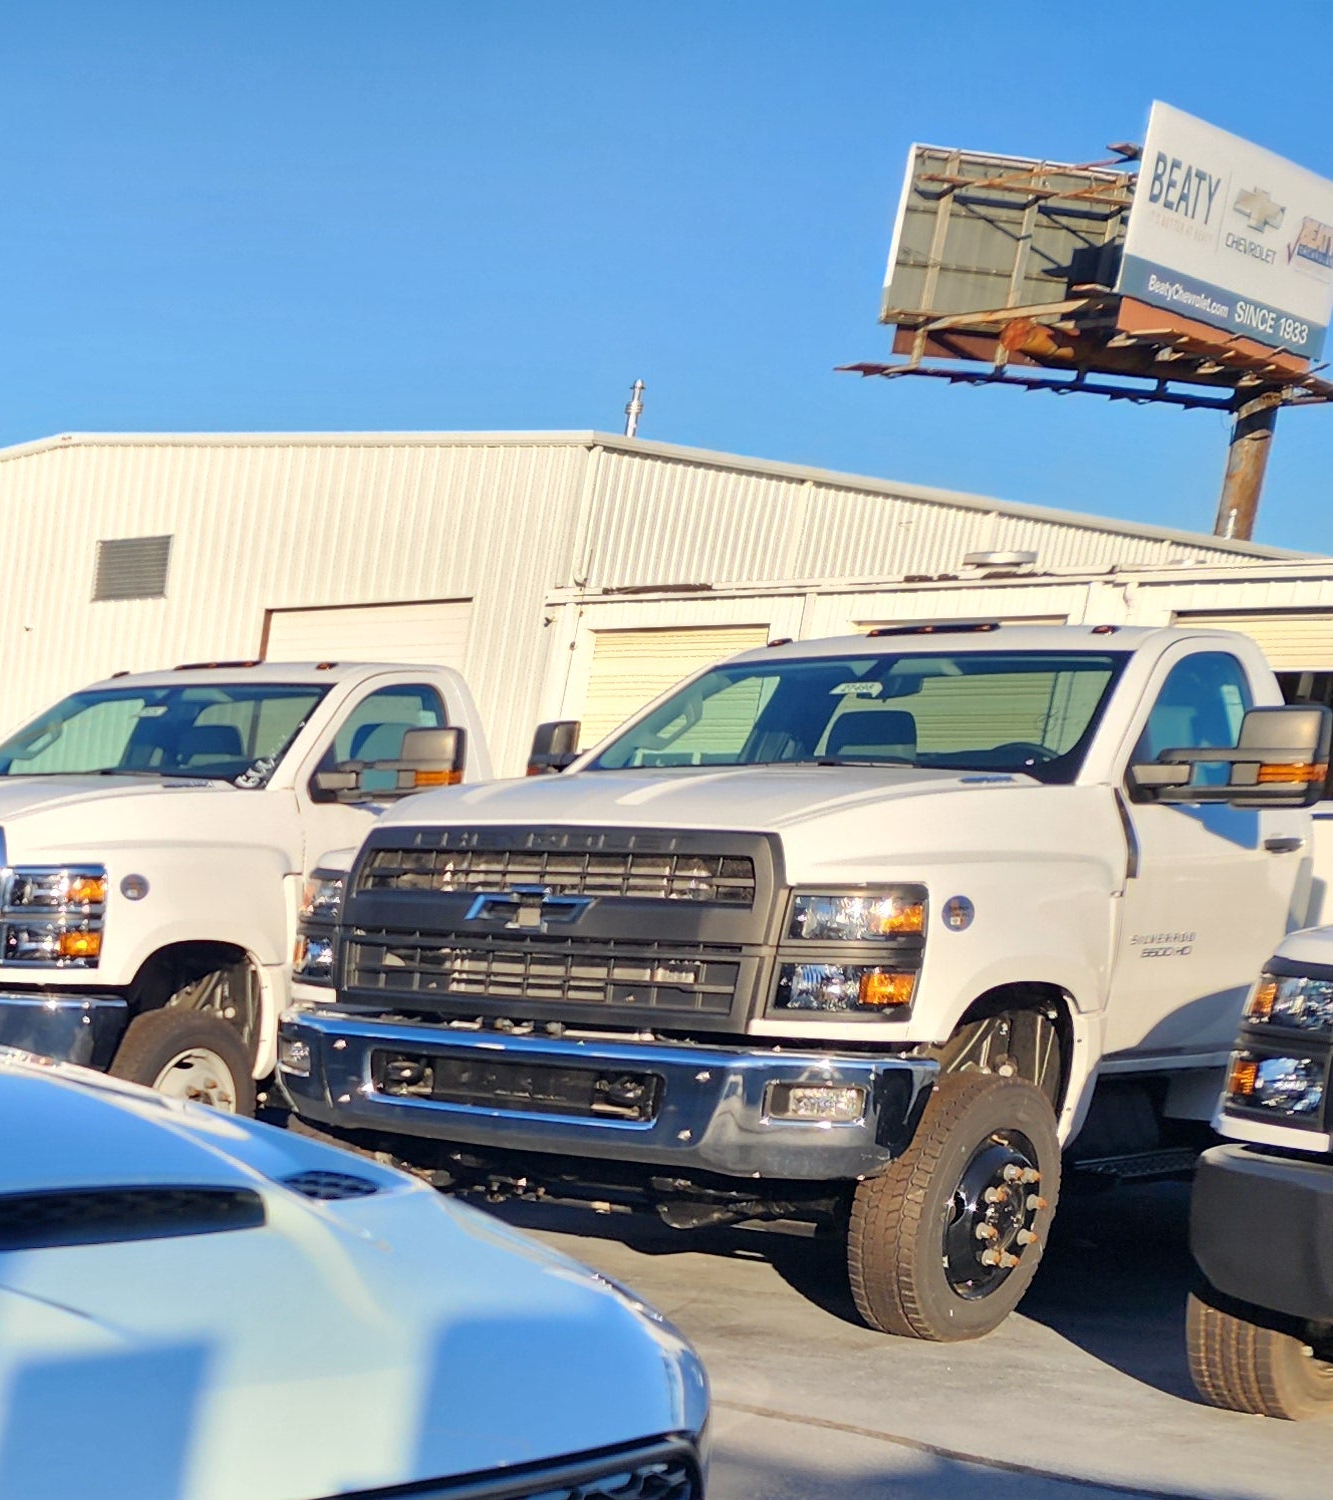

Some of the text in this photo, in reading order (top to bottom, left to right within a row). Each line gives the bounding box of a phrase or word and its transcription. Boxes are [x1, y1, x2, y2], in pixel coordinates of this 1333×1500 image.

[1148, 151, 1221, 225] BEATY
[1225, 232, 1278, 265] CHEVROLET
[1148, 274, 1229, 318] BeatyChevrolet.com
[1234, 300, 1309, 345] SINCE 1933
[1130, 931, 1197, 946] SILVERADO
